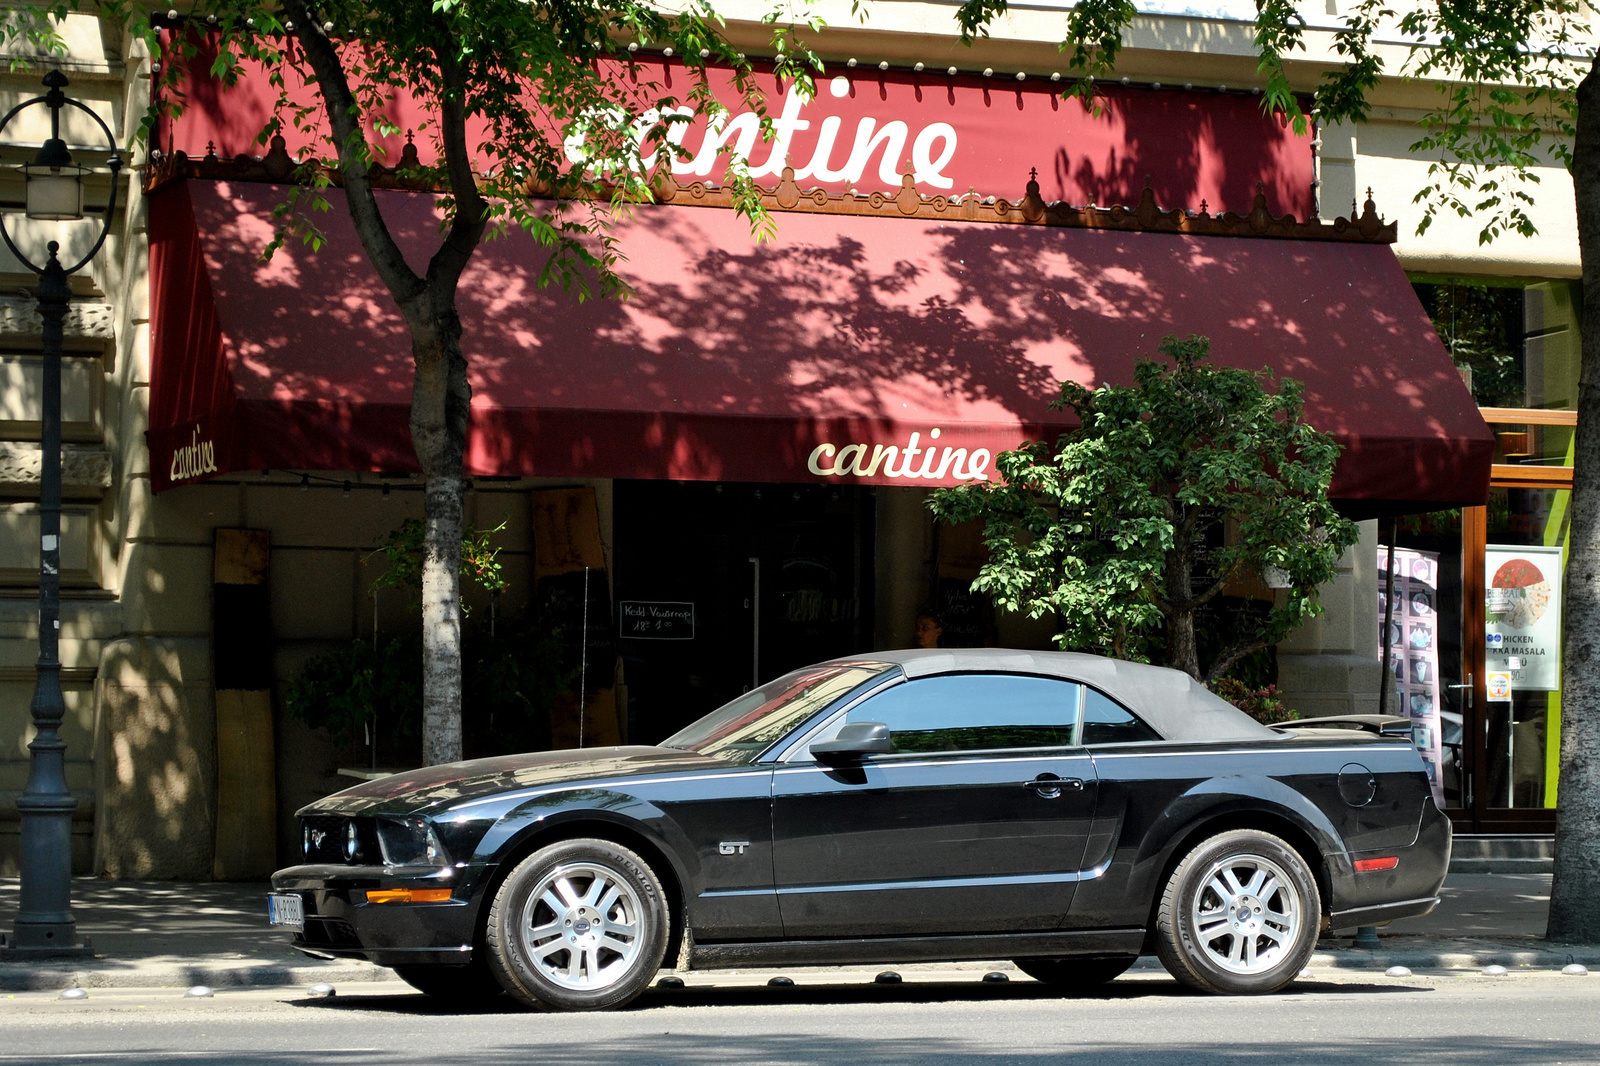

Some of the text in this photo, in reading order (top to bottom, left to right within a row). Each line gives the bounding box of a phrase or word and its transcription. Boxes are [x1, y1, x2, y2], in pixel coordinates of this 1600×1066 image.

[564, 76, 957, 189] cantine
[170, 423, 217, 481] cantine
[807, 428, 990, 480] cantine
[1503, 635, 1533, 644] HICKEN
[1511, 647, 1546, 656] MASALA
[719, 841, 750, 855] GT
[614, 854, 657, 903] DUNLOP
